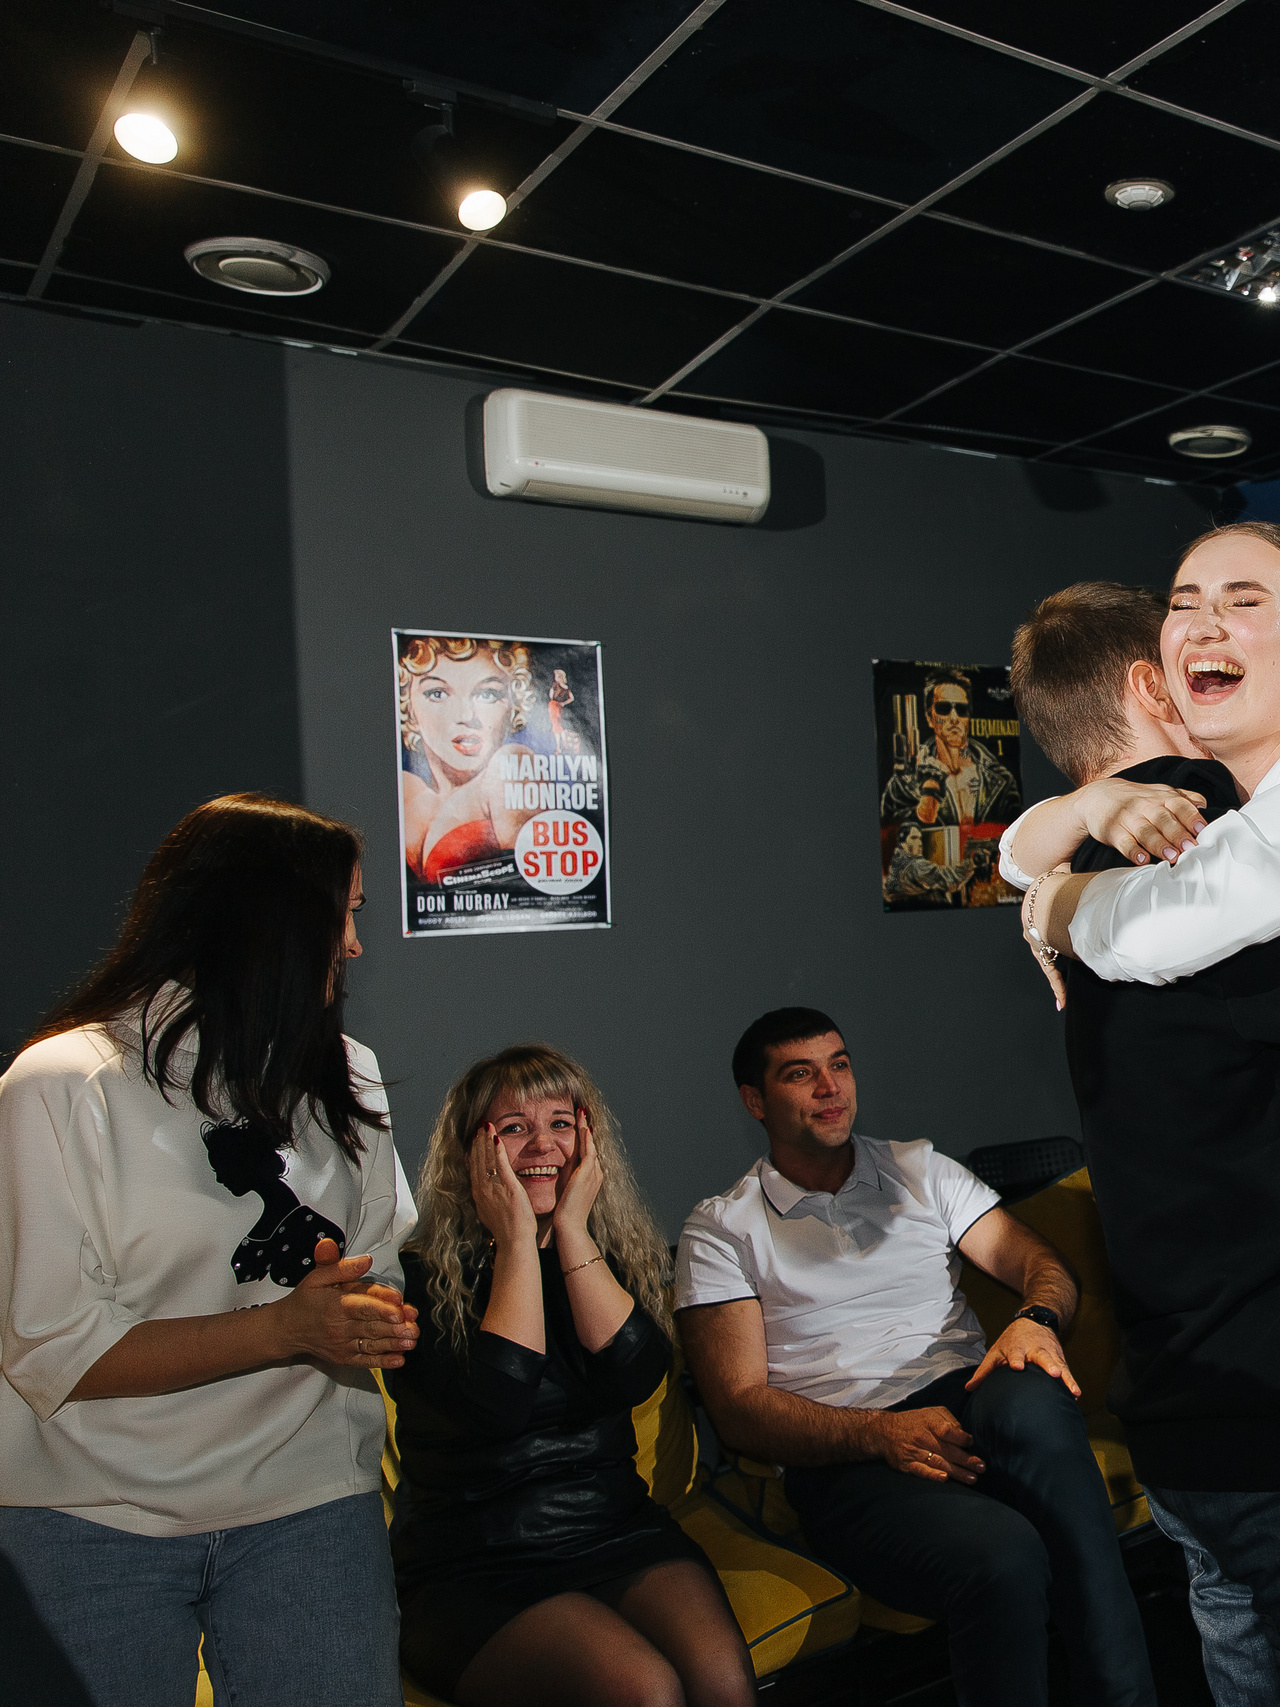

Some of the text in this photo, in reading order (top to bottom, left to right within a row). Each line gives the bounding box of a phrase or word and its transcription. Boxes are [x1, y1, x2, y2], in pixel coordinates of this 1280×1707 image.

[501, 754, 597, 782] MARILYN
[504, 782, 598, 810] MONROE
[532, 821, 588, 847] BUS
[523, 850, 599, 877] STOP
[417, 893, 509, 912] DON MURRAY
